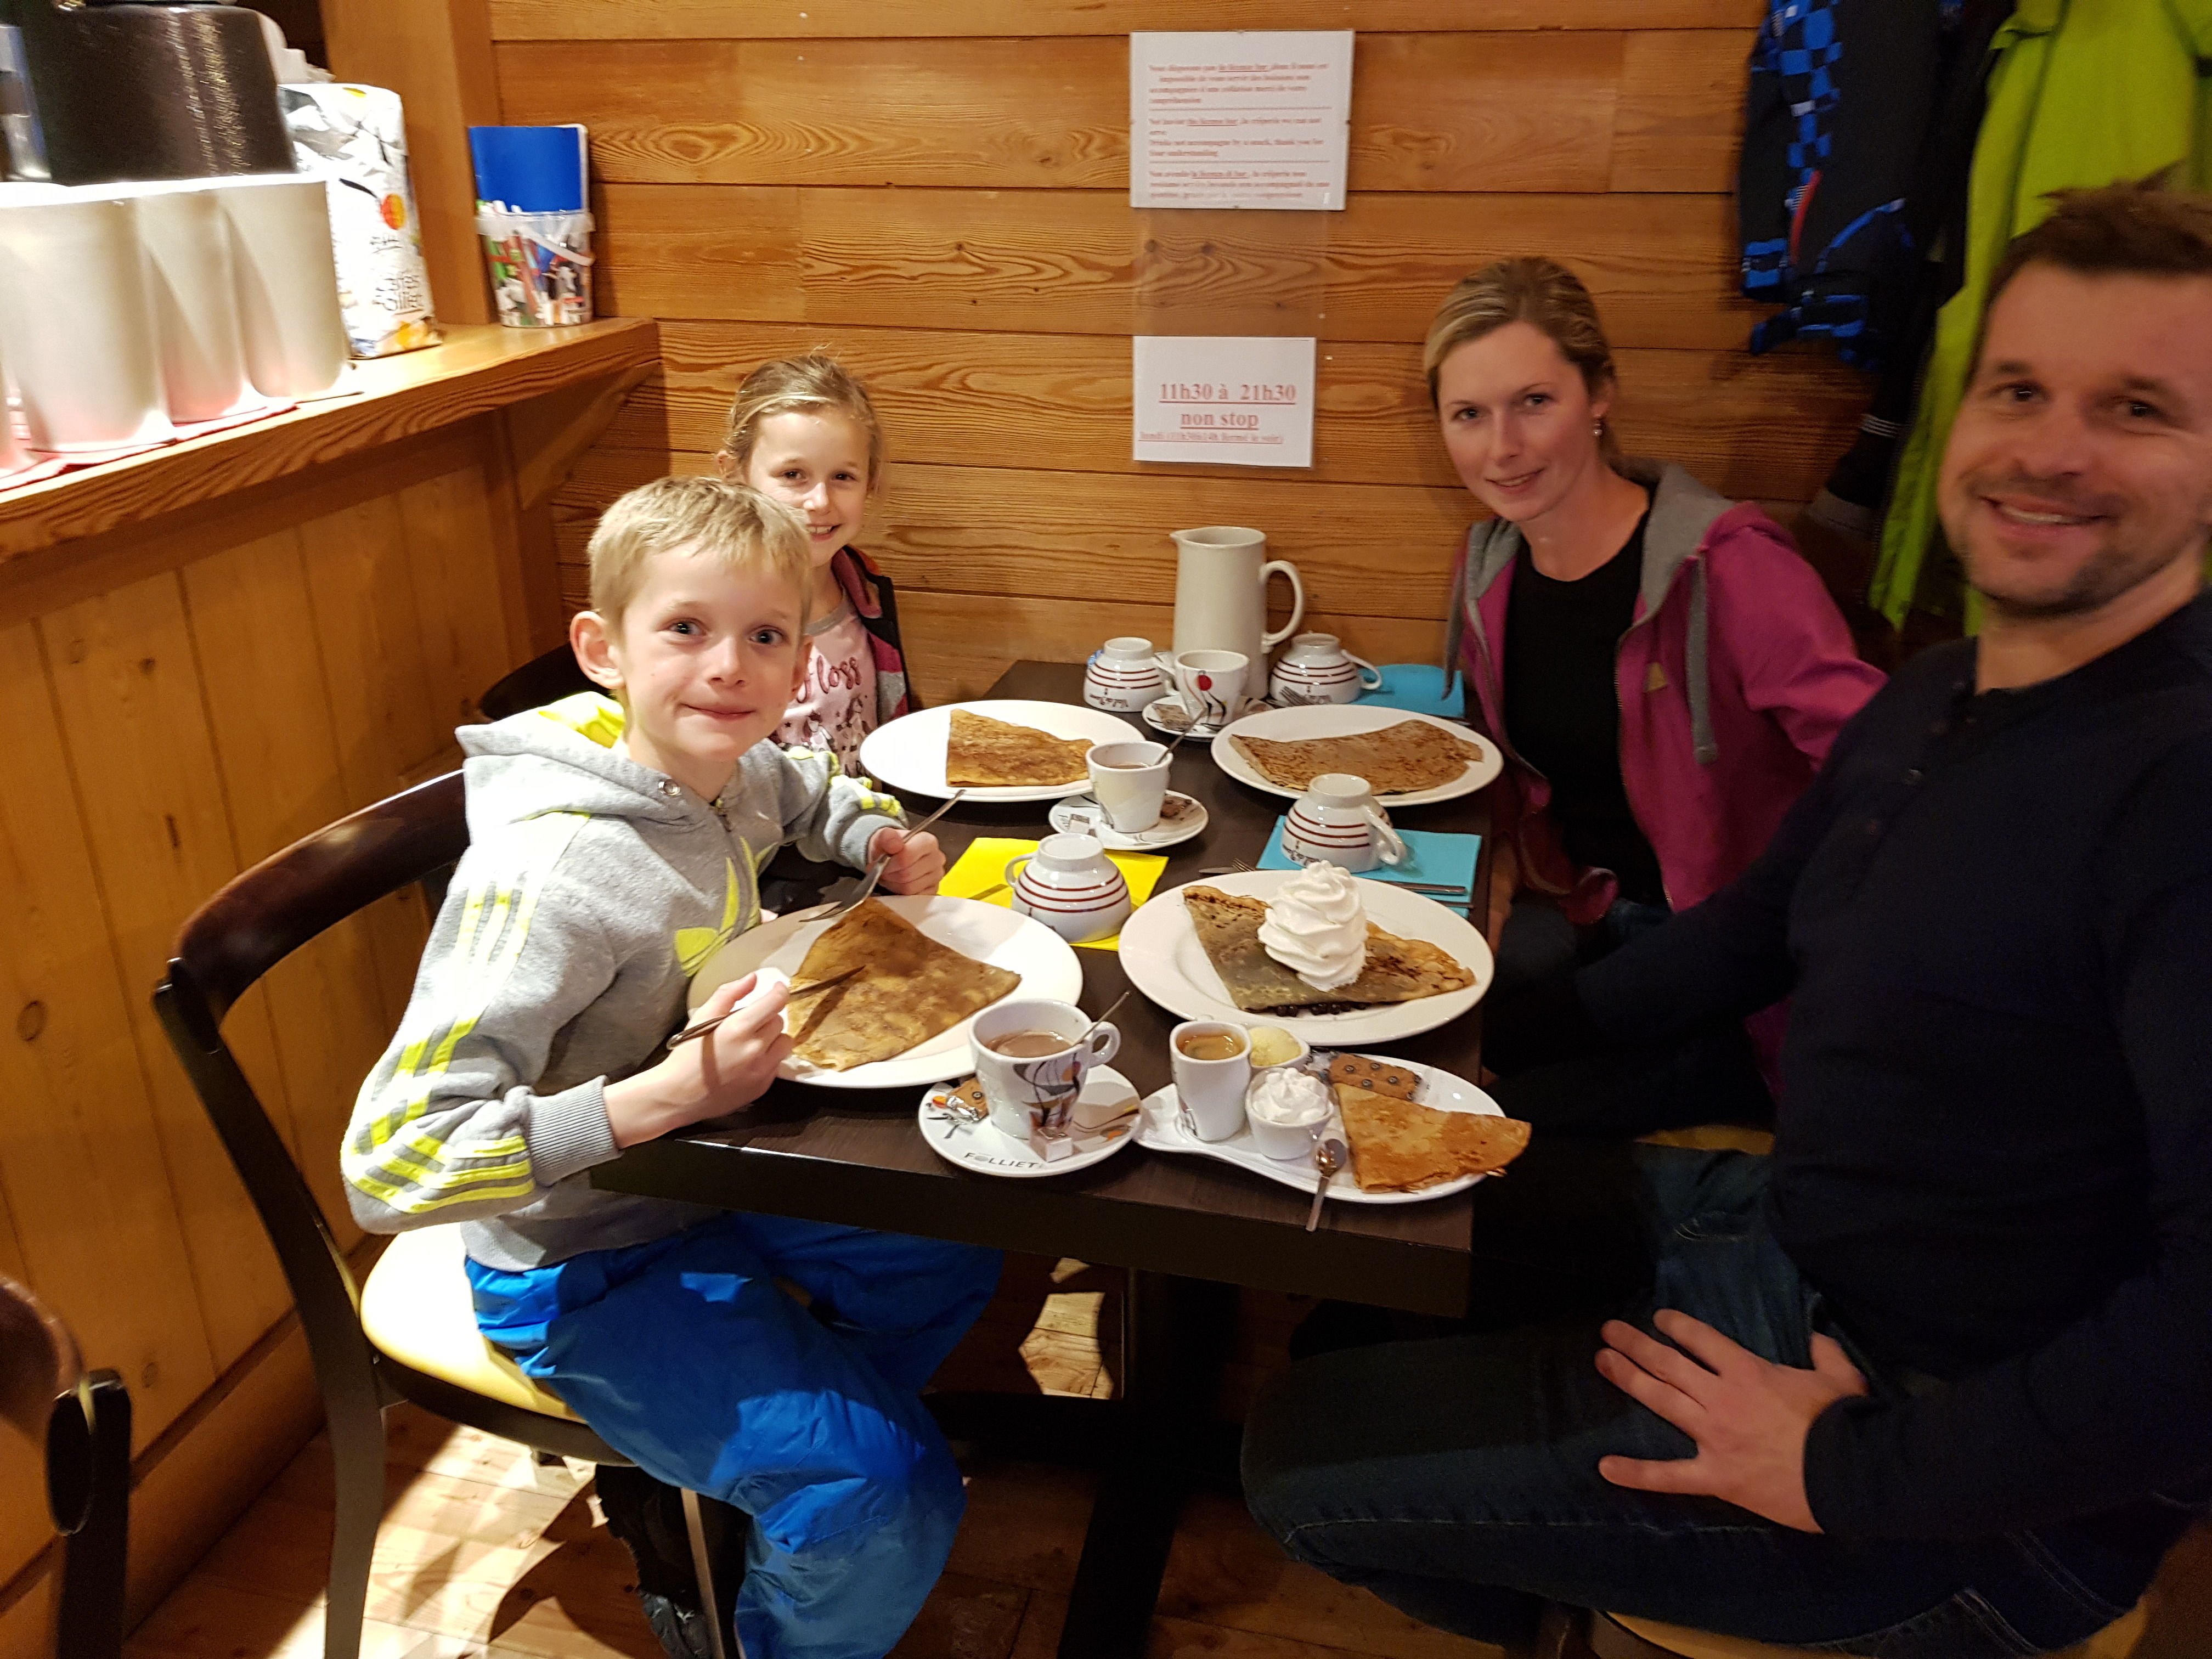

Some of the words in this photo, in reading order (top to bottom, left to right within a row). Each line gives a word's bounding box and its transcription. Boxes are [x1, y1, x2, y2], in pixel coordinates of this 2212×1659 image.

[1161, 383, 1214, 400] 11h30
[1218, 383, 1228, 400] à
[1240, 385, 1296, 400] 21h30
[1181, 413, 1214, 426] non
[1220, 413, 1259, 428] stop
